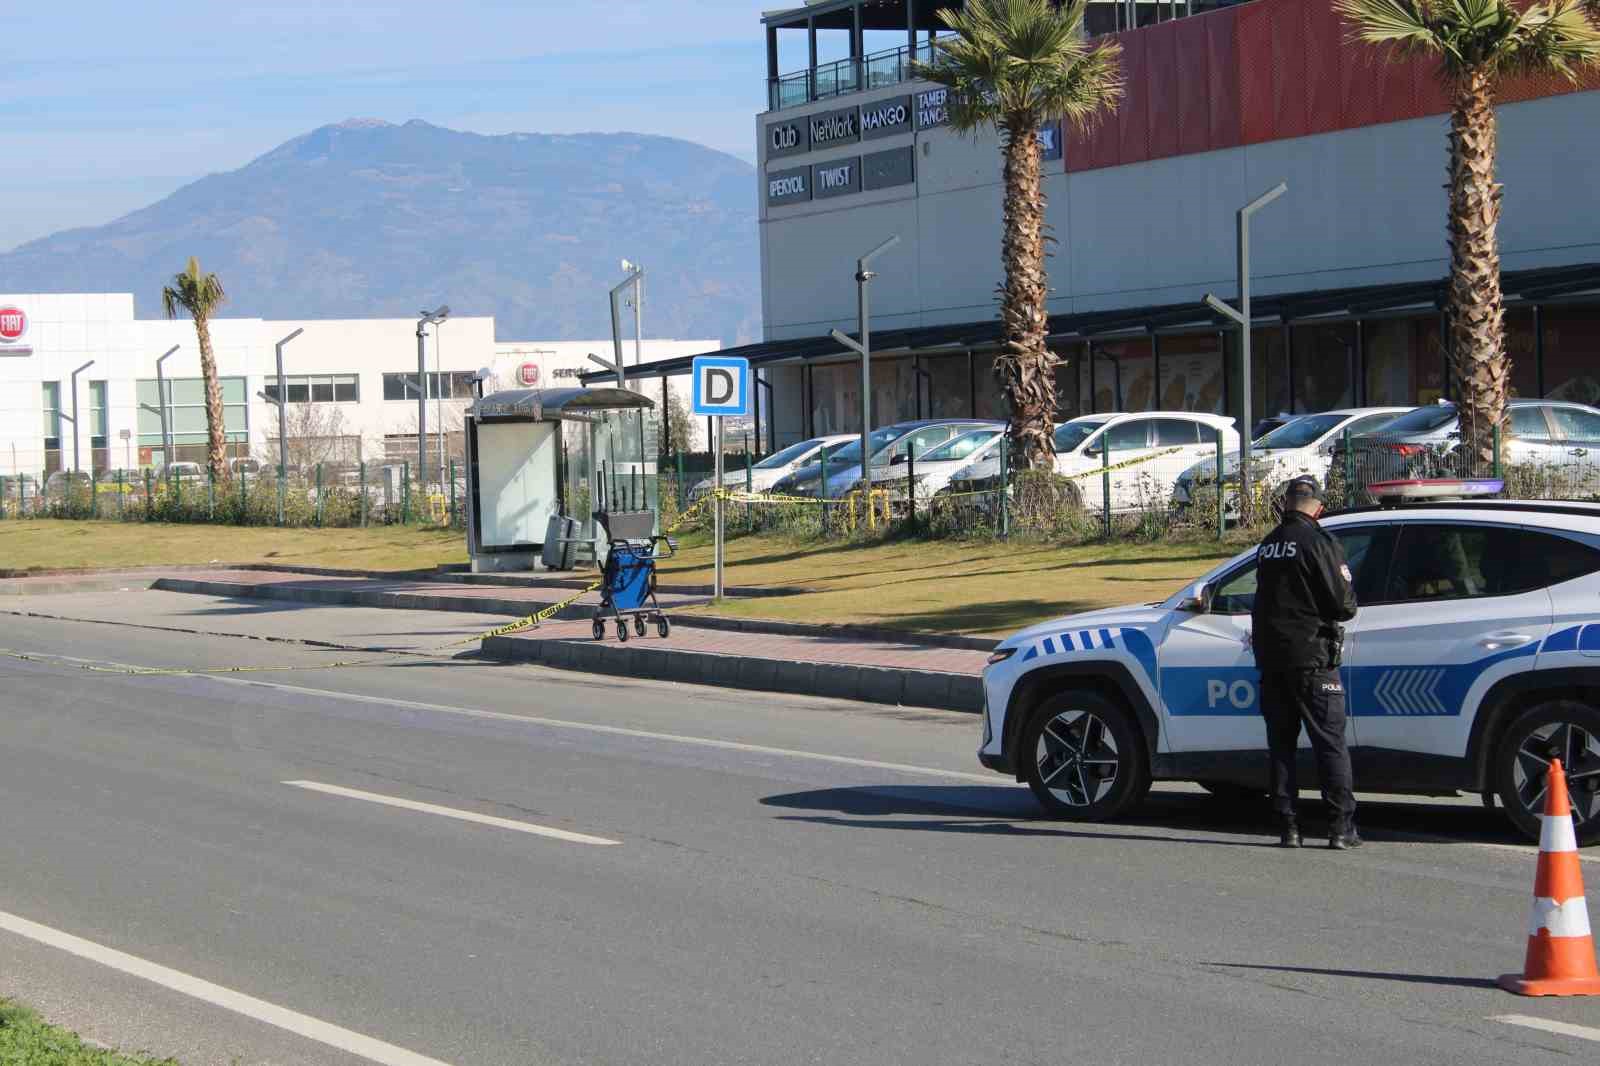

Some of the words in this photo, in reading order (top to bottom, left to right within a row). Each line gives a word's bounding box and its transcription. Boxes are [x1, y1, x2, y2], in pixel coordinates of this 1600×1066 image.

[860, 105, 904, 131] MANGO
[772, 126, 796, 150] Club
[820, 166, 851, 189] TWIST
[1, 314, 23, 331] FIAT
[705, 368, 734, 405] D
